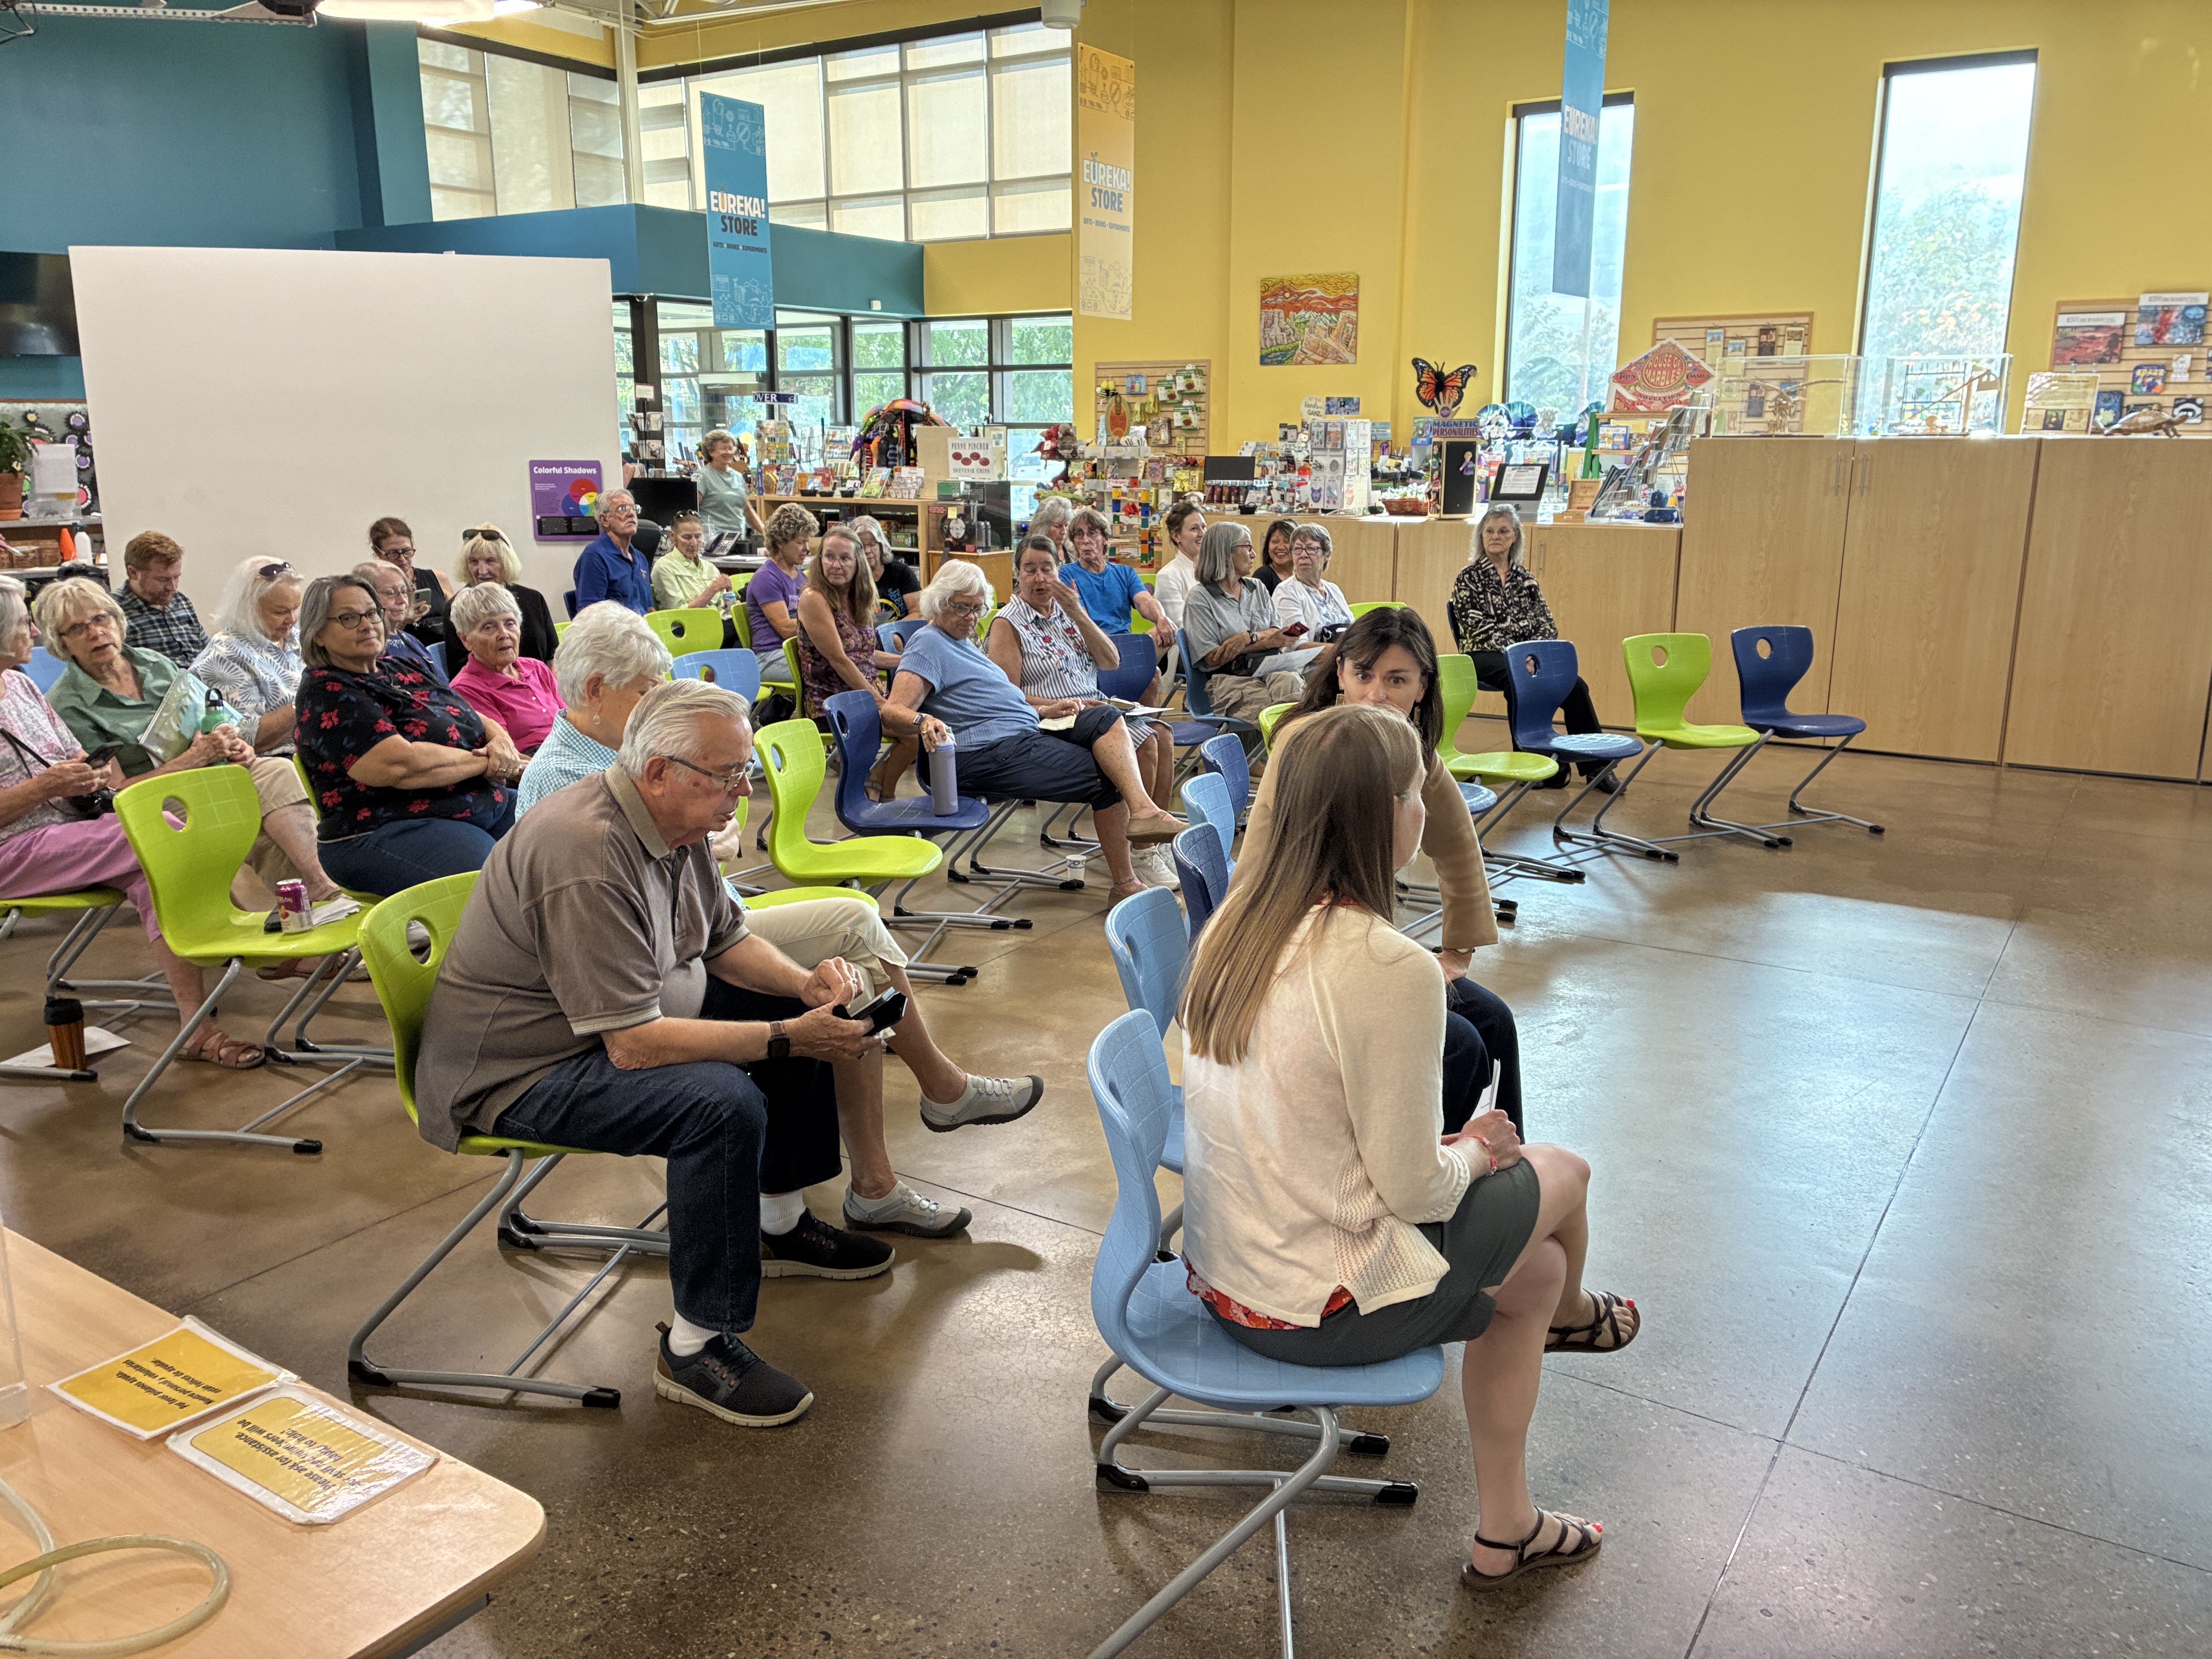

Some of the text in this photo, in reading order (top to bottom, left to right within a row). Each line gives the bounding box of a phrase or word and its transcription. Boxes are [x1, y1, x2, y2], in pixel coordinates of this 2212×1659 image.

[1564, 104, 1599, 145] EUREKA!
[1568, 138, 1592, 170] STORE
[1084, 159, 1131, 192] EUREKA!
[710, 190, 765, 218] EUREKA!
[1091, 187, 1123, 212] STORE
[721, 215, 758, 236] STORE
[1095, 219, 1106, 228] BOOKS
[1647, 353, 1682, 369] HOUSE OF
[1646, 368, 1681, 386] MARBLES
[1638, 393, 1680, 402] NOVELTIES
[1432, 427, 1478, 436] PERSONALITIES
[122, 1359, 159, 1379] voluntarios
[150, 1358, 176, 1372] ayudar.
[158, 1379, 193, 1395] personal
[180, 1375, 205, 1387] felices
[157, 1394, 178, 1404] favor
[187, 1392, 215, 1405] Nuestro
[237, 1419, 252, 1429] be
[245, 1424, 267, 1436] will
[263, 1432, 308, 1459] volunteers
[280, 1428, 344, 1463] happy to help!
[274, 1455, 292, 1466] for
[287, 1462, 308, 1474] ask
[319, 1465, 347, 1479] staff
[304, 1471, 336, 1491] Please
